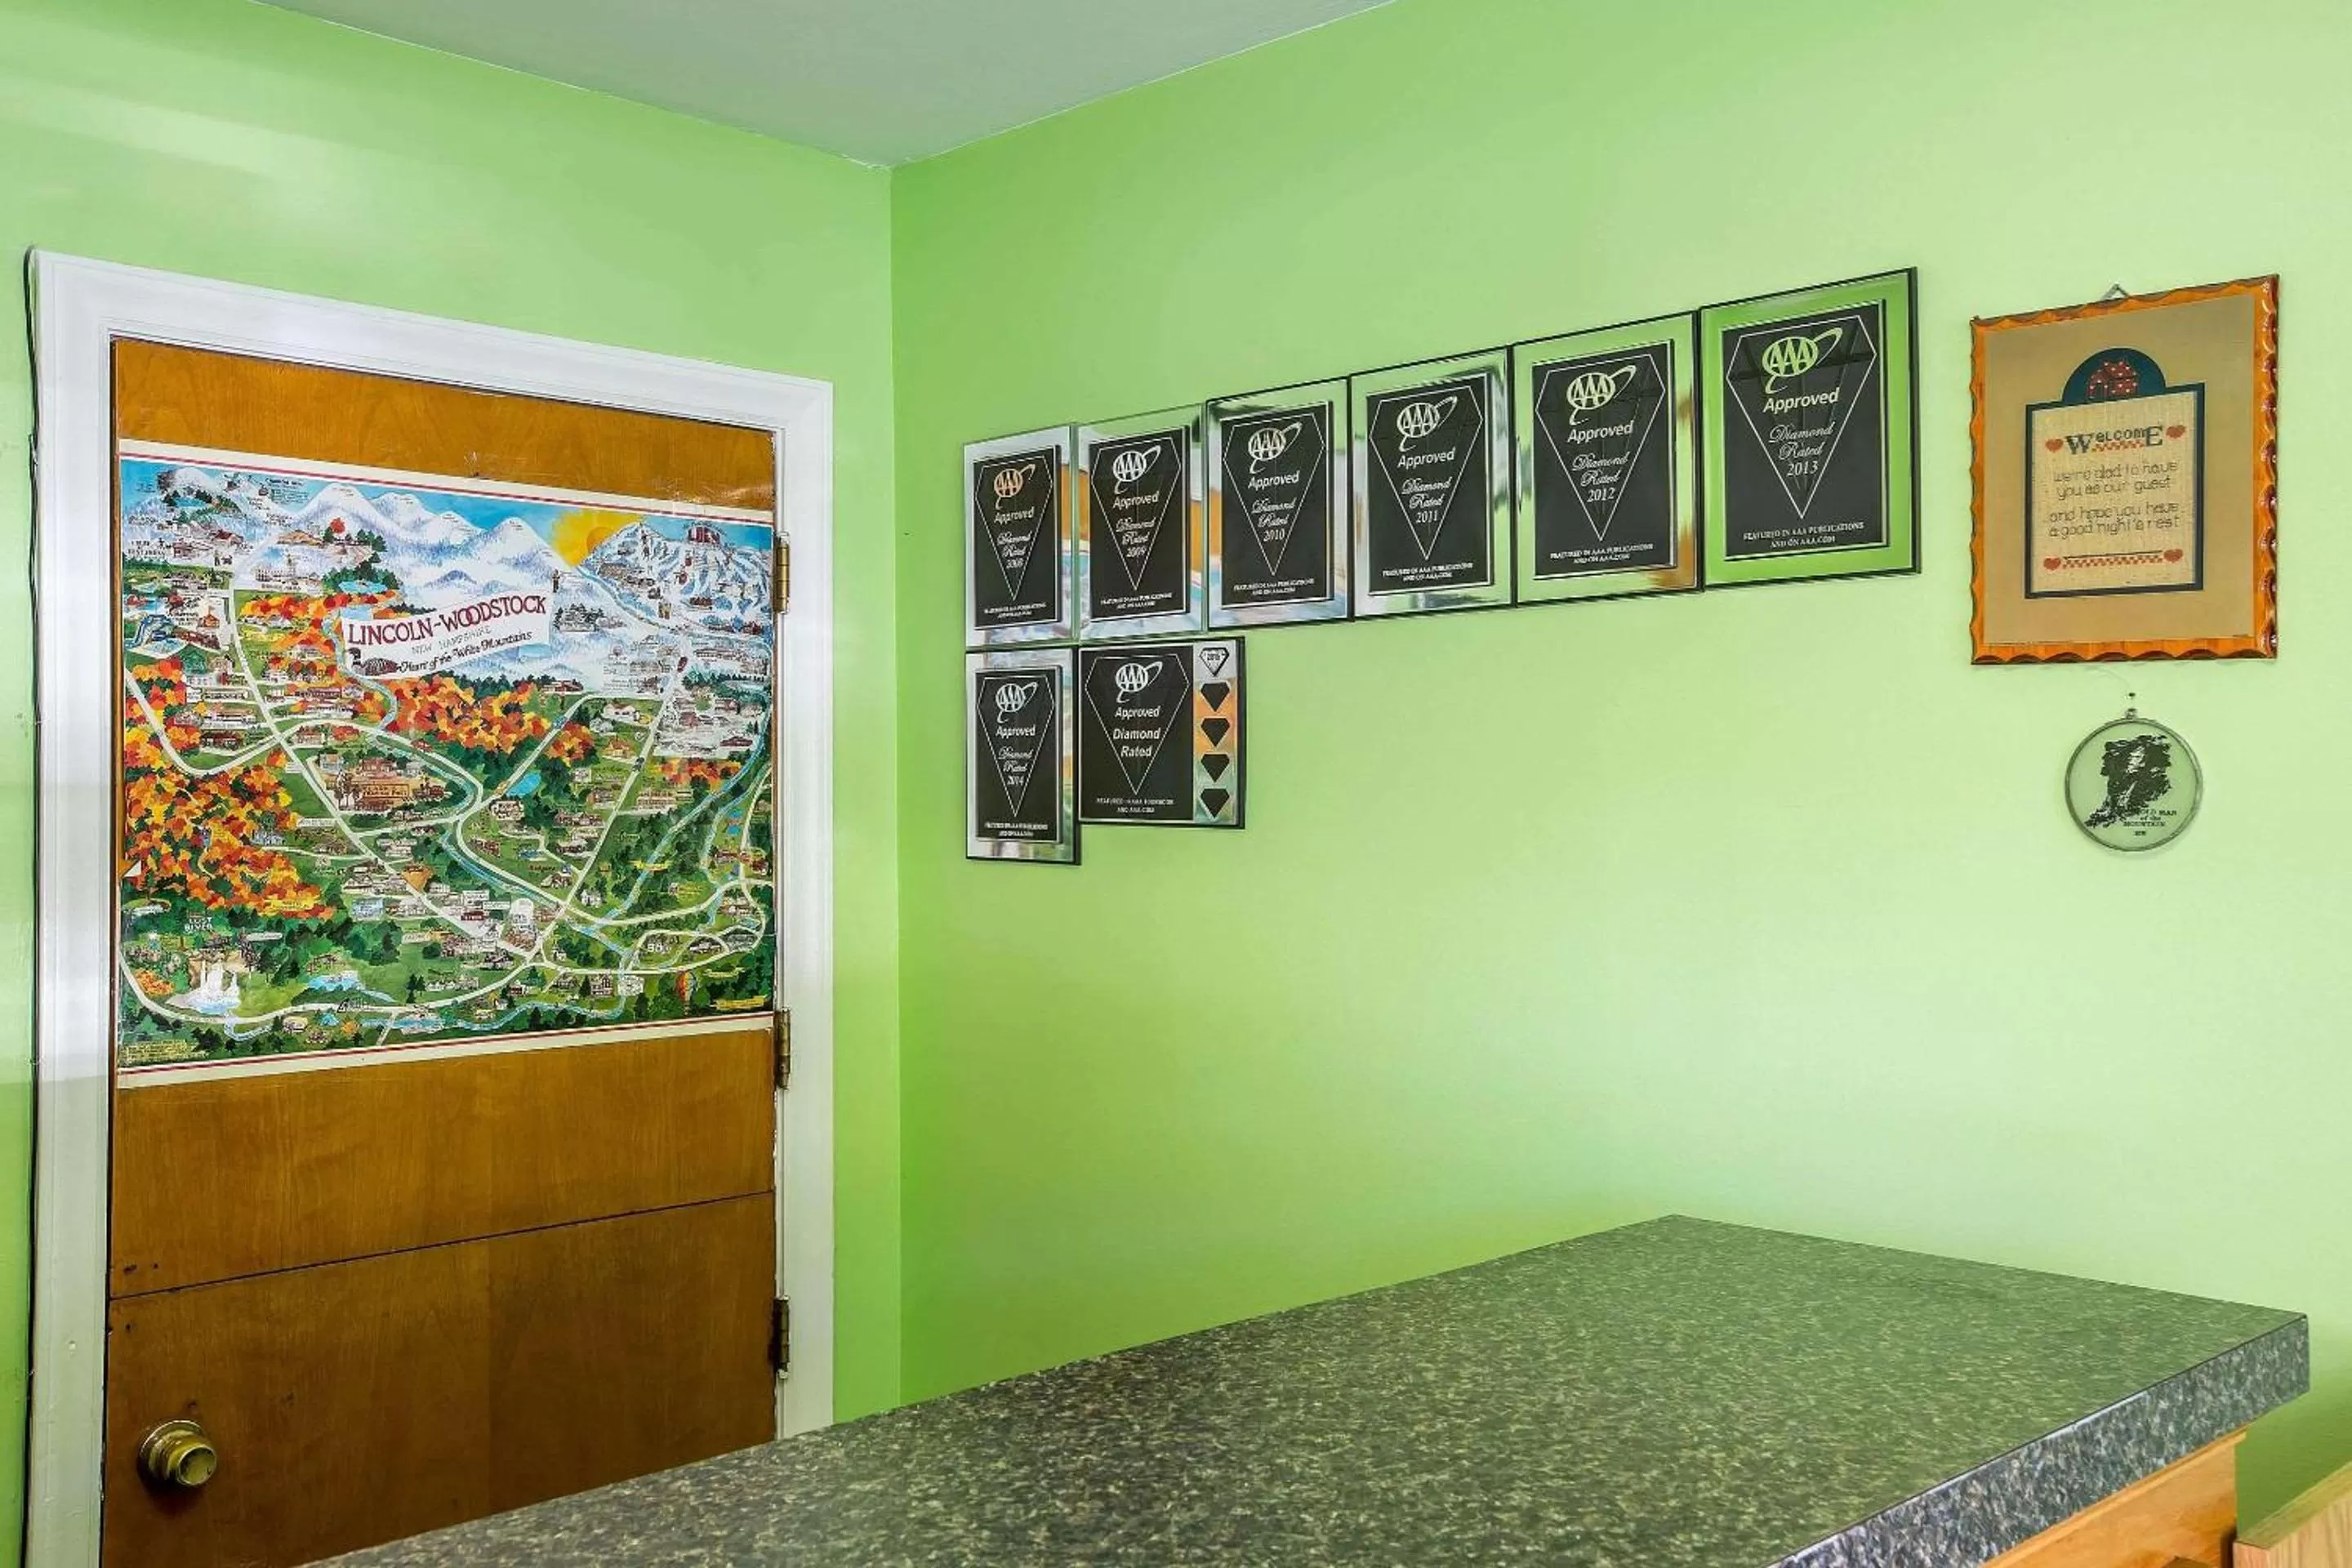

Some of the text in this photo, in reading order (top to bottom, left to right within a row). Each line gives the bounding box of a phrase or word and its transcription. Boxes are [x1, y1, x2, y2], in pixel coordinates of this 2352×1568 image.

[1762, 336, 1818, 376] AAA
[1566, 372, 1616, 410] AAA
[1763, 388, 1839, 413] Approved
[1396, 403, 1441, 438] AAA
[1567, 419, 1634, 443] Approved
[1768, 421, 1835, 443] Diamond
[1248, 427, 1286, 461] AAA
[1779, 441, 1825, 460] Rated
[1113, 451, 1147, 482] AAA
[1396, 447, 1456, 470] Approved
[1571, 452, 1631, 472] Diamond
[1580, 466, 1621, 487] Rated
[1787, 461, 1818, 477] 2013
[994, 468, 1023, 497] AAA
[1248, 470, 1300, 491] Approved
[1401, 476, 1453, 494] Diamond
[2057, 486, 2082, 501] you
[2134, 475, 2171, 494] guest
[1113, 490, 1160, 510] Approved
[1409, 493, 1445, 510] Rated
[1586, 487, 1615, 503] 2012
[994, 506, 1035, 524] Approved
[1415, 510, 1438, 523] 2011
[2147, 515, 2180, 529] rest
[1263, 528, 1285, 541] 2010
[1793, 528, 1807, 536] AAA
[1809, 522, 1864, 534] PUBLICATIONS
[1116, 662, 1148, 692] AAA
[996, 684, 1026, 712] AAA
[1115, 705, 1160, 719] Approved
[996, 724, 1036, 739] Approved
[1113, 727, 1160, 740] Diamond
[1120, 745, 1153, 757] Rated
